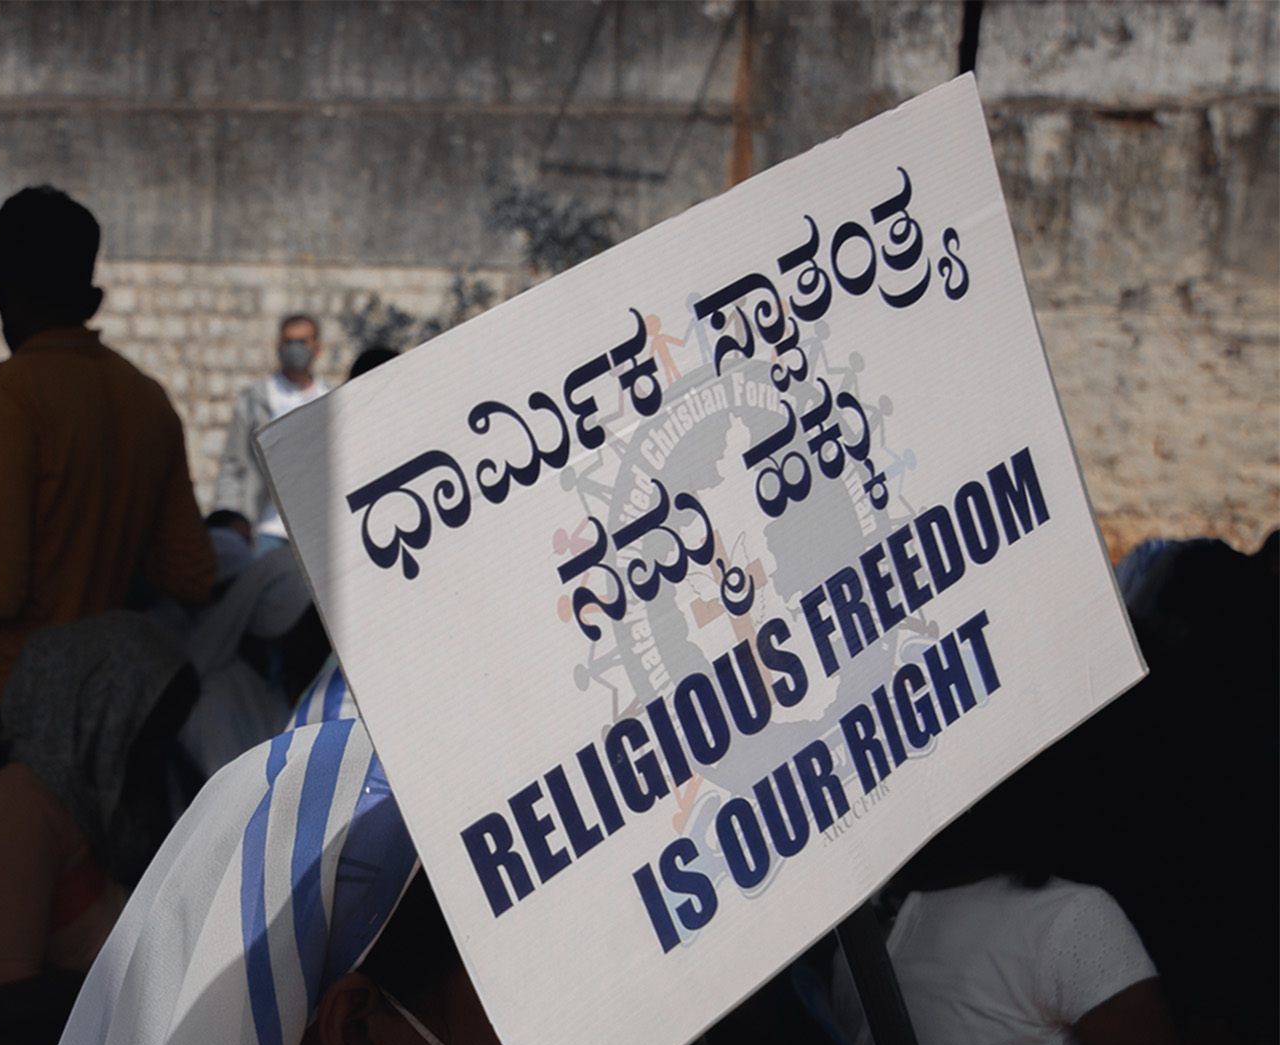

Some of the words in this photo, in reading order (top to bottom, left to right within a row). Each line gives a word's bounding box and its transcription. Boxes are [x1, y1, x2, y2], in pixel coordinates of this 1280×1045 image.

[346, 308, 663, 580] ಧಾರ್ಮಿಕ
[694, 167, 970, 393] ಸ್ವಾತಂತ್ರ್ಯ
[558, 479, 755, 642] ನಮ್ಮ
[743, 378, 889, 517] ಹಕ್ಕು
[640, 383, 730, 471] Christian
[460, 618, 809, 916] RELIGIOUS
[801, 447, 1051, 677] FREEDOM
[633, 838, 718, 953] IS
[716, 740, 851, 889] OUR
[840, 610, 1001, 795] RIGHT
